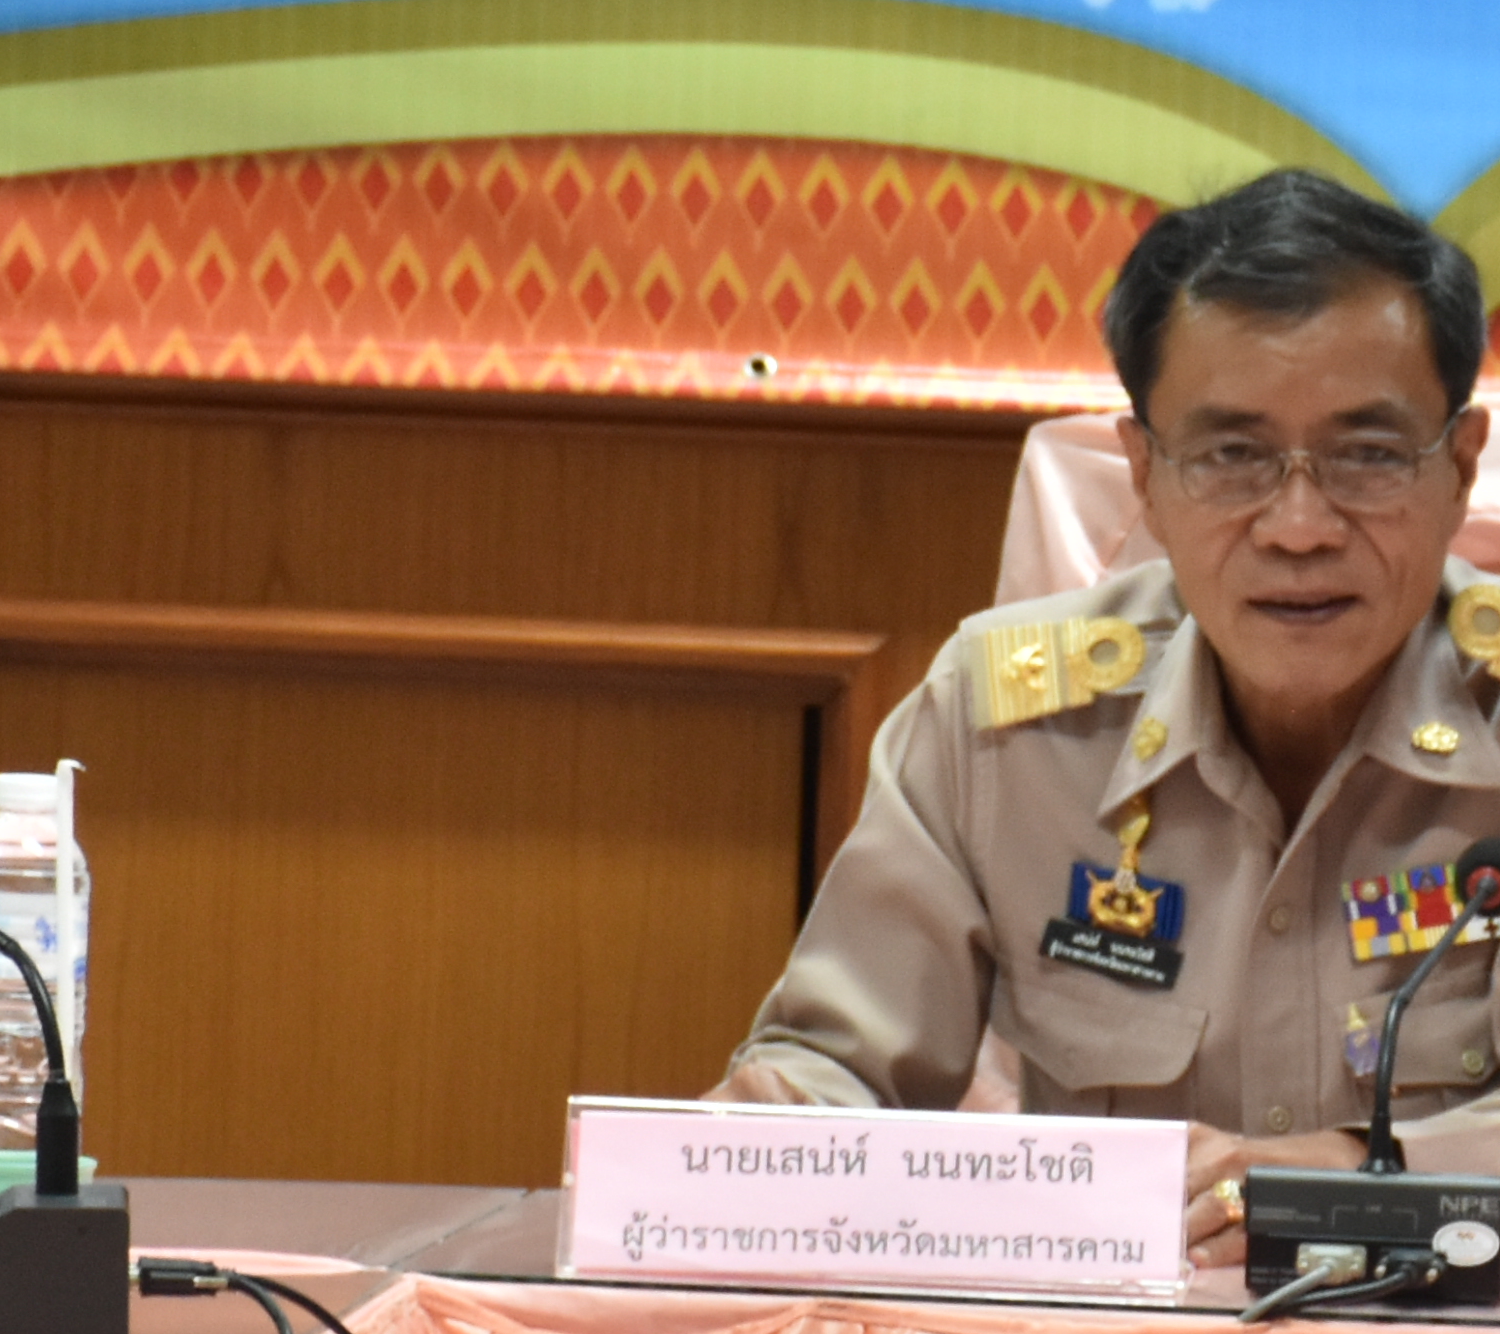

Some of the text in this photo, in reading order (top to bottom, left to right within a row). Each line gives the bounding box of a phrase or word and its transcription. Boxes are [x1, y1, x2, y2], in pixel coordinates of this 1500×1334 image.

[681, 1131, 1094, 1184] นายเสน่ห์ นนทะโชติ
[1439, 1194, 1499, 1215] NPE
[621, 1210, 1145, 1264] ผู้ว่าราชการจังหวัดมหาสารคาม
